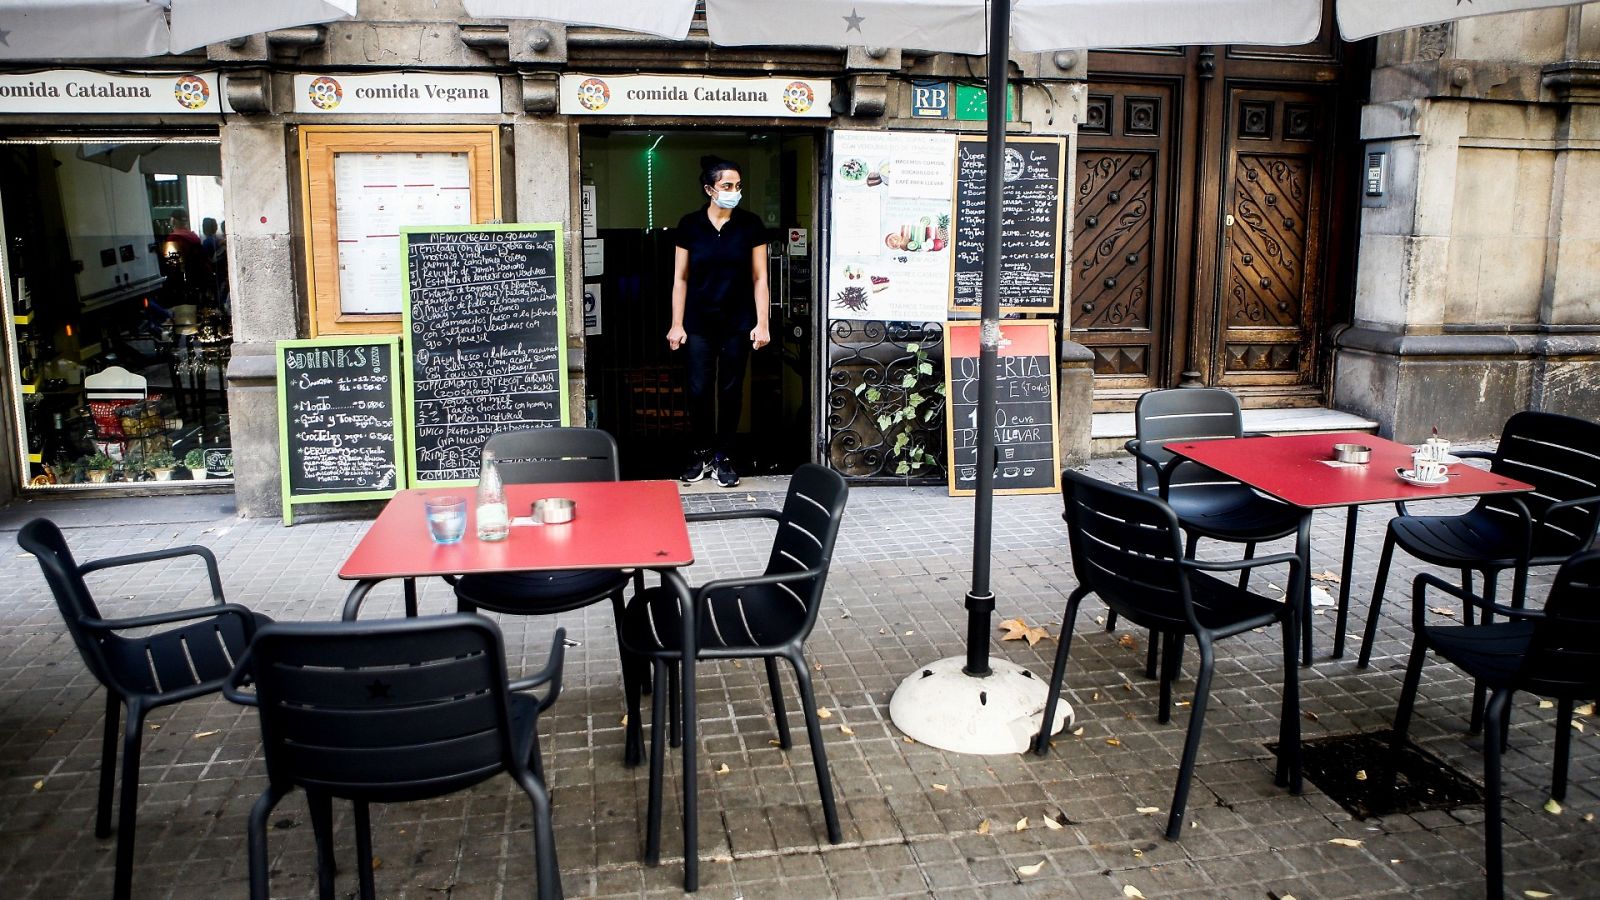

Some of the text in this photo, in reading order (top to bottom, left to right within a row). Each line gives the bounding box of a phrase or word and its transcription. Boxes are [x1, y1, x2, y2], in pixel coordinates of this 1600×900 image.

[0, 81, 151, 98] omida Catalana
[355, 84, 490, 102] comida Vegana
[626, 86, 769, 102] comida Catalana
[915, 88, 946, 108] RB
[451, 259, 460, 267] de
[422, 331, 438, 342] con
[1011, 415, 1034, 424] euro
